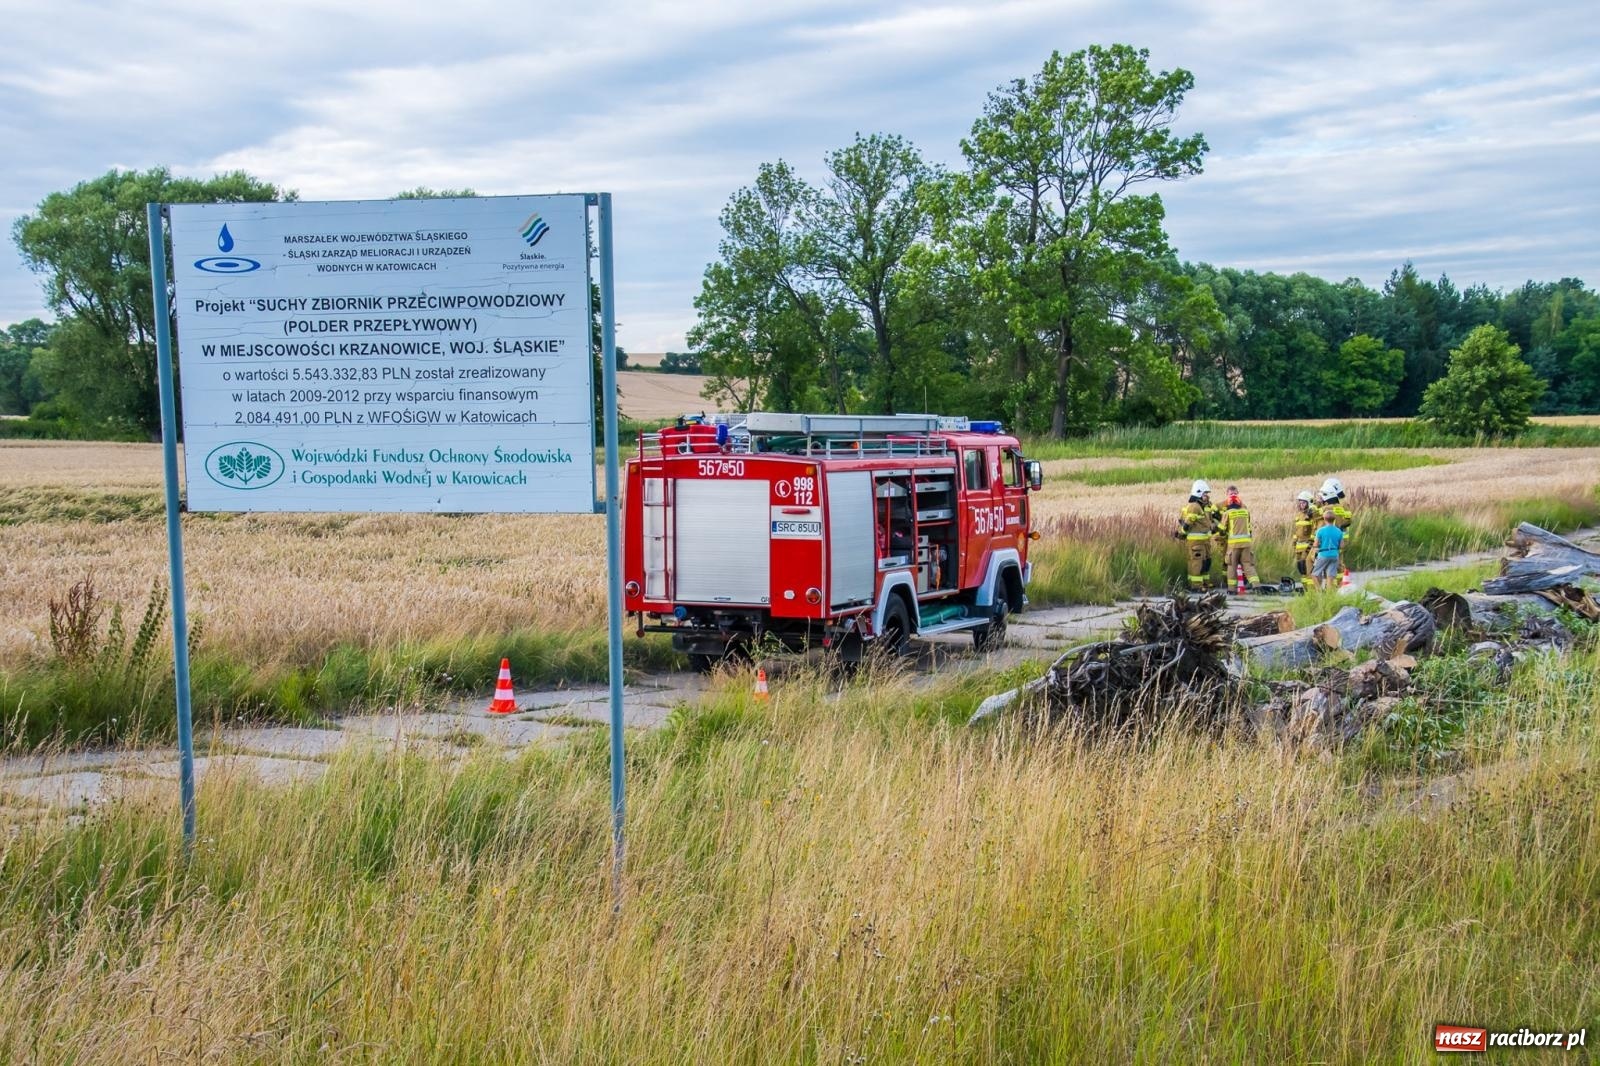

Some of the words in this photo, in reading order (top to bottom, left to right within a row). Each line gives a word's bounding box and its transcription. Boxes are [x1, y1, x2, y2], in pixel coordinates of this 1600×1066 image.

[284, 234, 338, 243] MARSZAŁEK
[341, 232, 413, 242] WOJEWÓDZTWA
[415, 231, 468, 243] ŚLĄSKIEGO
[288, 249, 320, 260] ŚLĄSKI
[322, 249, 358, 259] ZARZĄD
[360, 248, 415, 257] MELIORACJI
[416, 248, 420, 256] I
[422, 245, 471, 257] URZĄDZEŃ
[317, 264, 363, 272] WODNYCH
[365, 263, 374, 272] W
[376, 262, 437, 271] KATOWICACH
[503, 263, 538, 271] Pozytywna
[540, 263, 565, 271] energia
[196, 299, 245, 315] Projekt
[312, 297, 383, 311] ZBIORNIK
[388, 294, 565, 309] PRZECIWPOWODZIOWY
[283, 319, 348, 336] (POLDER
[353, 317, 477, 333] PRZEPŁYWOWY)
[202, 345, 215, 357] W
[220, 341, 334, 357] MIEJSCOWOŚCI
[340, 342, 446, 356] KRZANOWICE,
[450, 341, 488, 354] WOJ.
[223, 372, 231, 381] o
[235, 368, 288, 381] wartości
[292, 367, 378, 382] 5.543.332,83
[382, 367, 410, 380] PLN
[415, 366, 454, 380] został
[458, 366, 546, 381] zrealizowany
[232, 393, 243, 402] w
[246, 390, 285, 402] latach
[290, 389, 359, 402] 2009-2012
[364, 391, 391, 405] przy
[396, 388, 454, 404] wsparciu
[459, 388, 538, 403] finansowym
[235, 411, 320, 425] 2.084.491,00
[324, 411, 352, 424] PLN
[357, 414, 364, 423] z
[368, 408, 441, 424] WFOŚiGW
[445, 413, 456, 423] w
[461, 410, 537, 423] Katowicach
[292, 470, 296, 484] i
[436, 474, 447, 484] w
[793, 477, 814, 491] 998
[793, 491, 813, 505] 112
[777, 522, 795, 532] SRC
